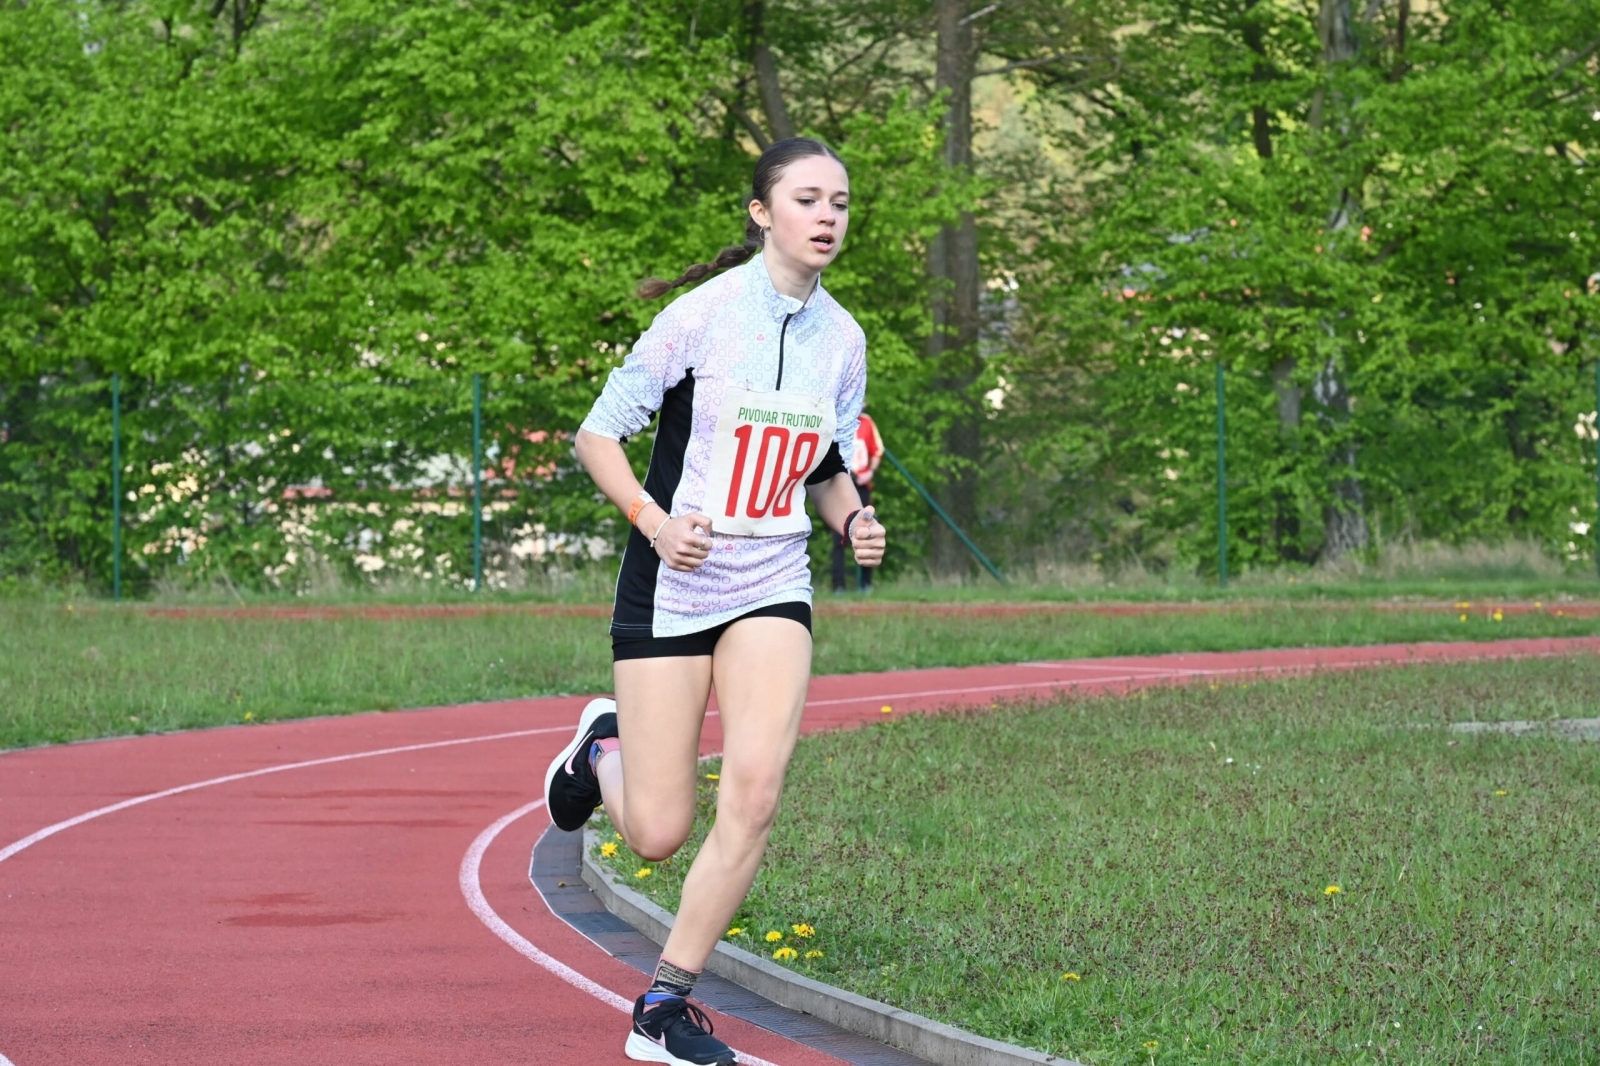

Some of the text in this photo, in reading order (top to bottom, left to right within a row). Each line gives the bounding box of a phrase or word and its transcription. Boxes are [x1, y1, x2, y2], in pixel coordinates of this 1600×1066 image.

[738, 407, 823, 428] PIVOVAR TRUTNOV
[725, 424, 820, 518] 108
